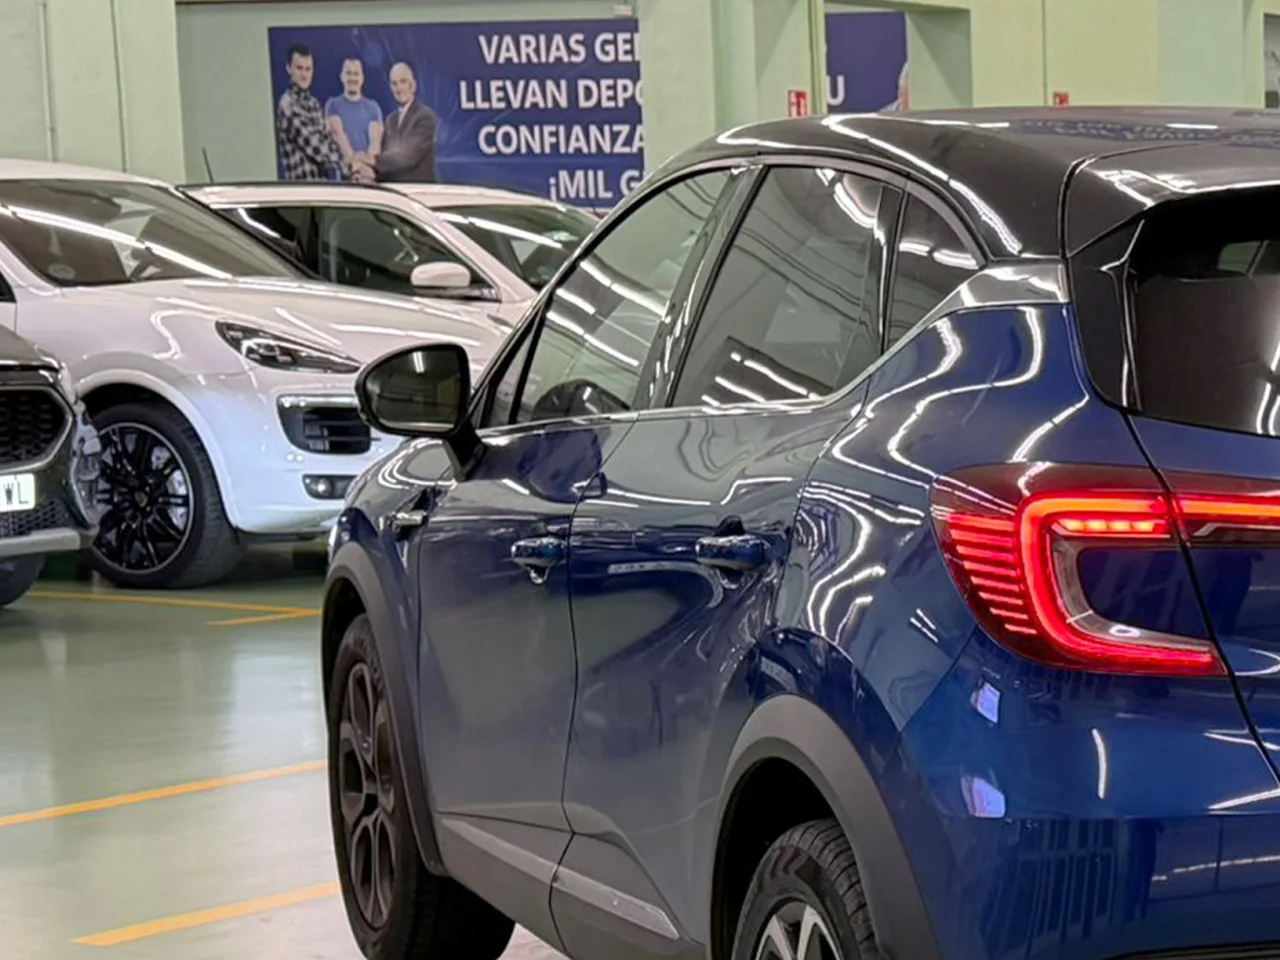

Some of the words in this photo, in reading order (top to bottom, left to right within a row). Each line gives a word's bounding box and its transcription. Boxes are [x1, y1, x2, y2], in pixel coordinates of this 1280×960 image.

[478, 32, 587, 65] VARIAS
[459, 78, 569, 110] LLEVAN
[620, 170, 646, 197] G
[0, 481, 30, 506] WL
